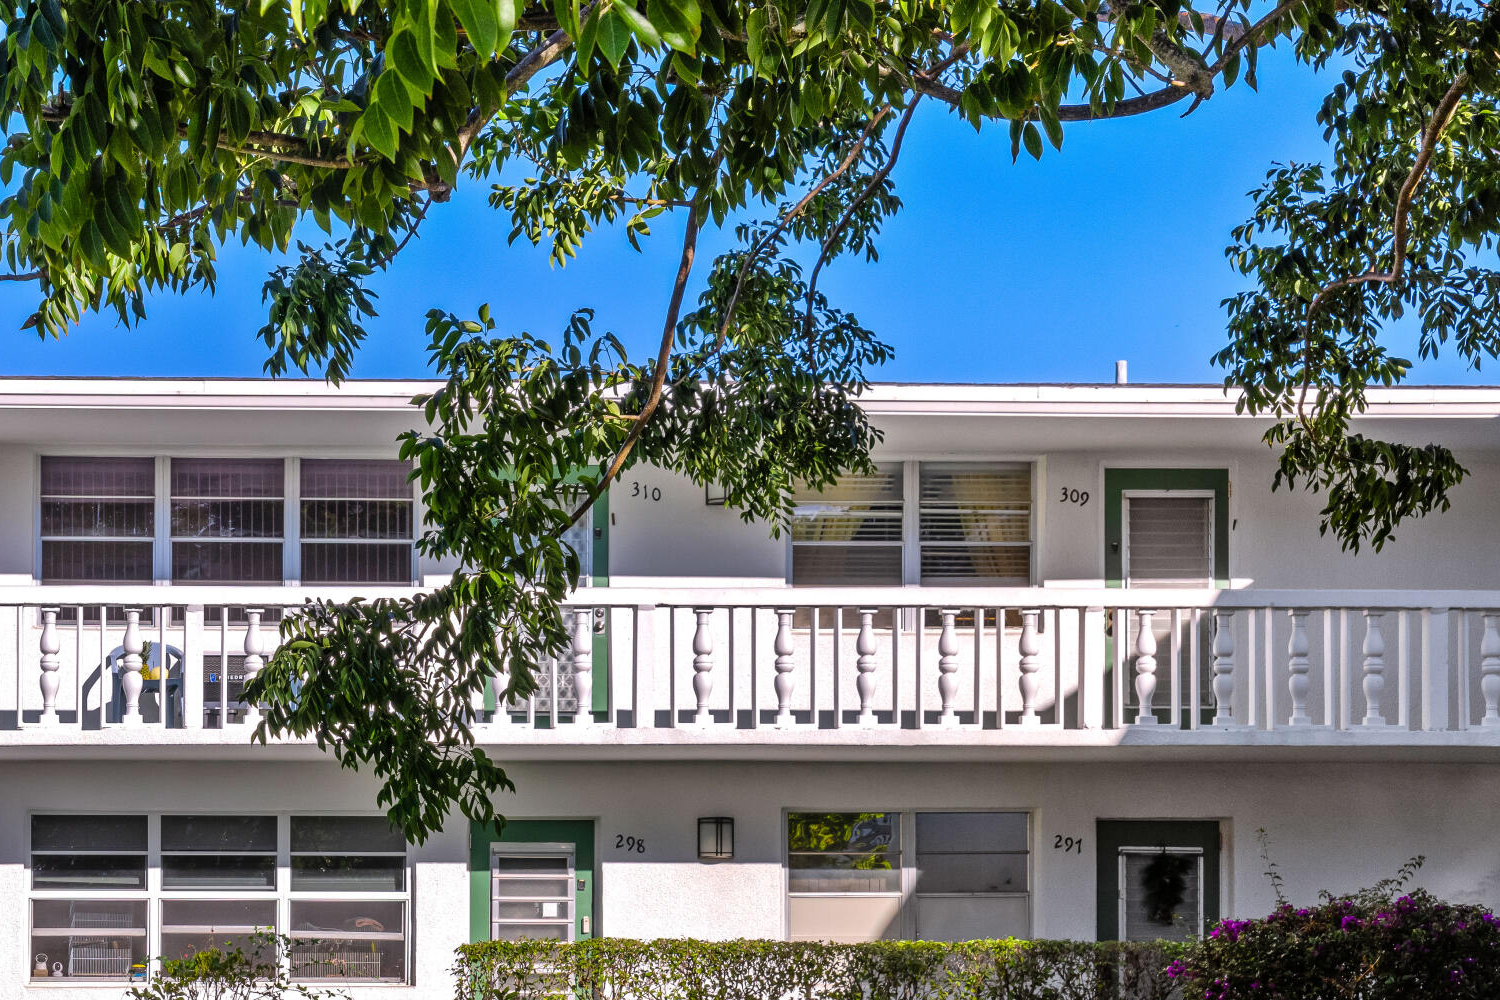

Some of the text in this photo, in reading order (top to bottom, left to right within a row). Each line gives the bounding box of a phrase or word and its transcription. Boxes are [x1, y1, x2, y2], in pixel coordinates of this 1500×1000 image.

[631, 481, 662, 501] 310
[1059, 486, 1090, 507] 309
[615, 834, 646, 854] 298
[1054, 834, 1083, 855] 297
